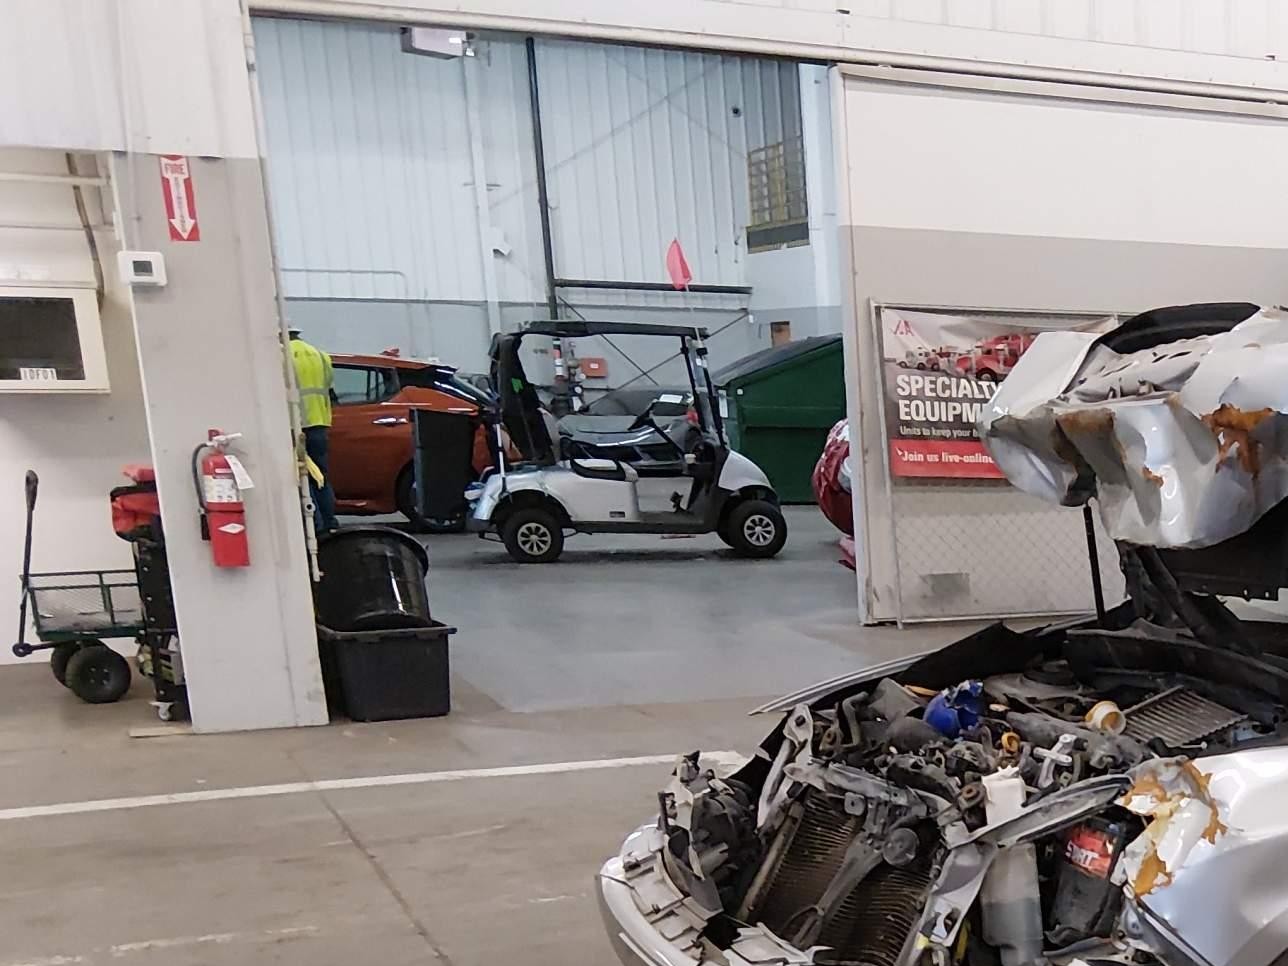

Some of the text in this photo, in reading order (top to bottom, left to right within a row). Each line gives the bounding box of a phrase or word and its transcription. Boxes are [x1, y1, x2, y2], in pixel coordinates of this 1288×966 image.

[899, 400, 981, 423] EQUIPM
[900, 425, 921, 435] Units
[922, 427, 931, 436] to
[932, 426, 951, 438] keep
[952, 428, 971, 439] your
[902, 450, 924, 462] Join
[926, 453, 939, 462] us
